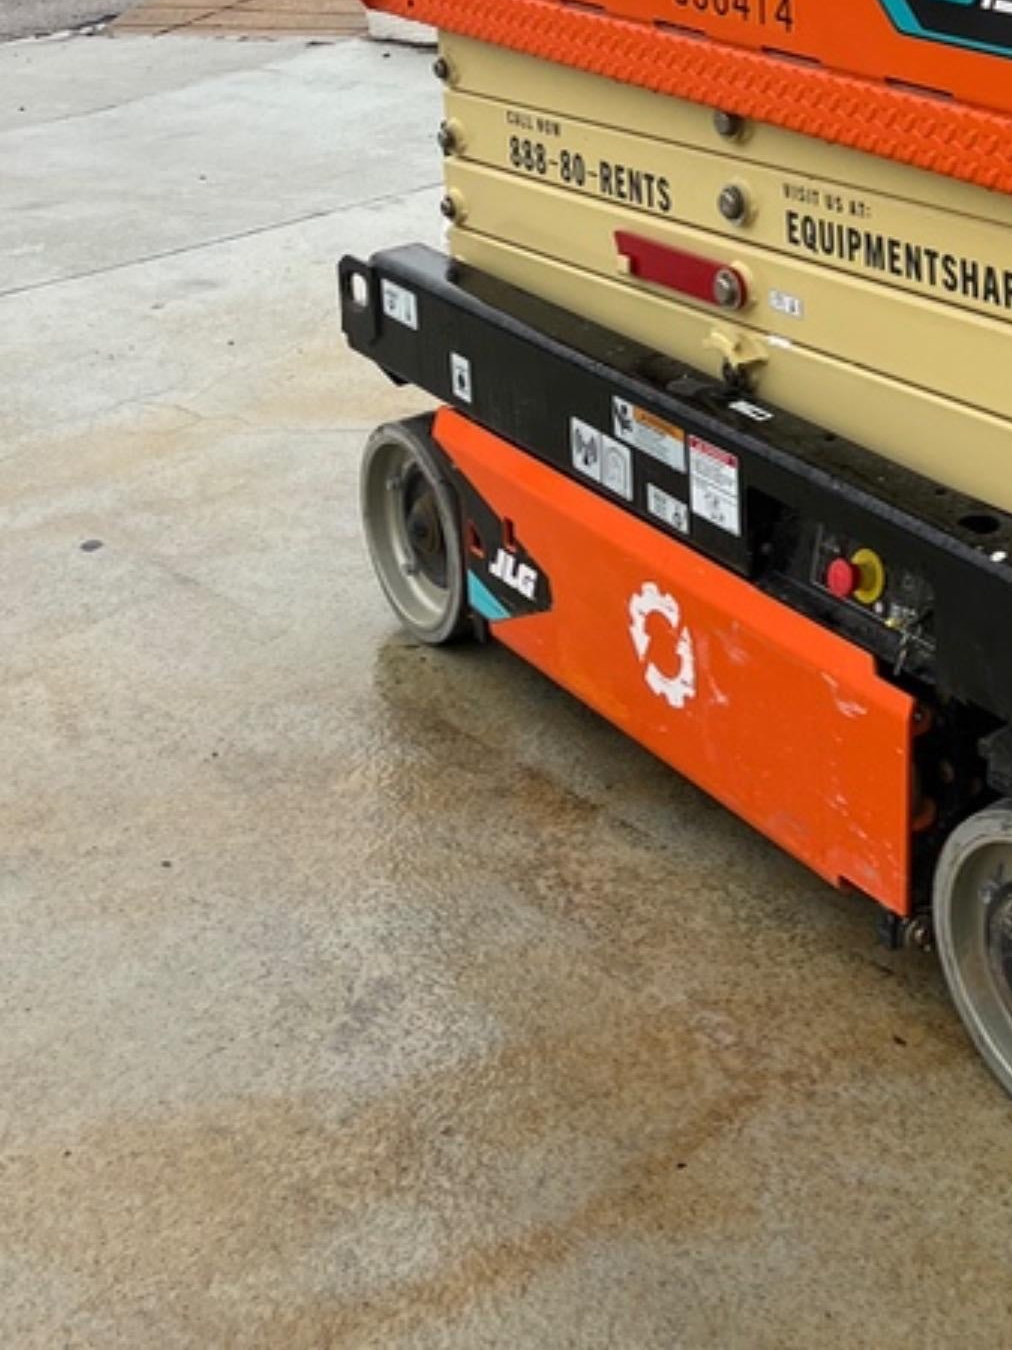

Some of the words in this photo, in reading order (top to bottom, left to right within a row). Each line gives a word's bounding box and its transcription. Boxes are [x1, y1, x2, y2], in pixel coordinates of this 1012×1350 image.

[506, 110, 533, 130] CALL
[536, 118, 561, 137] NOW
[509, 135, 672, 212] 888-80-RENTS
[783, 183, 820, 205] VISIT
[825, 195, 844, 213] US
[849, 200, 871, 218] AT:
[489, 548, 537, 600] JLG
